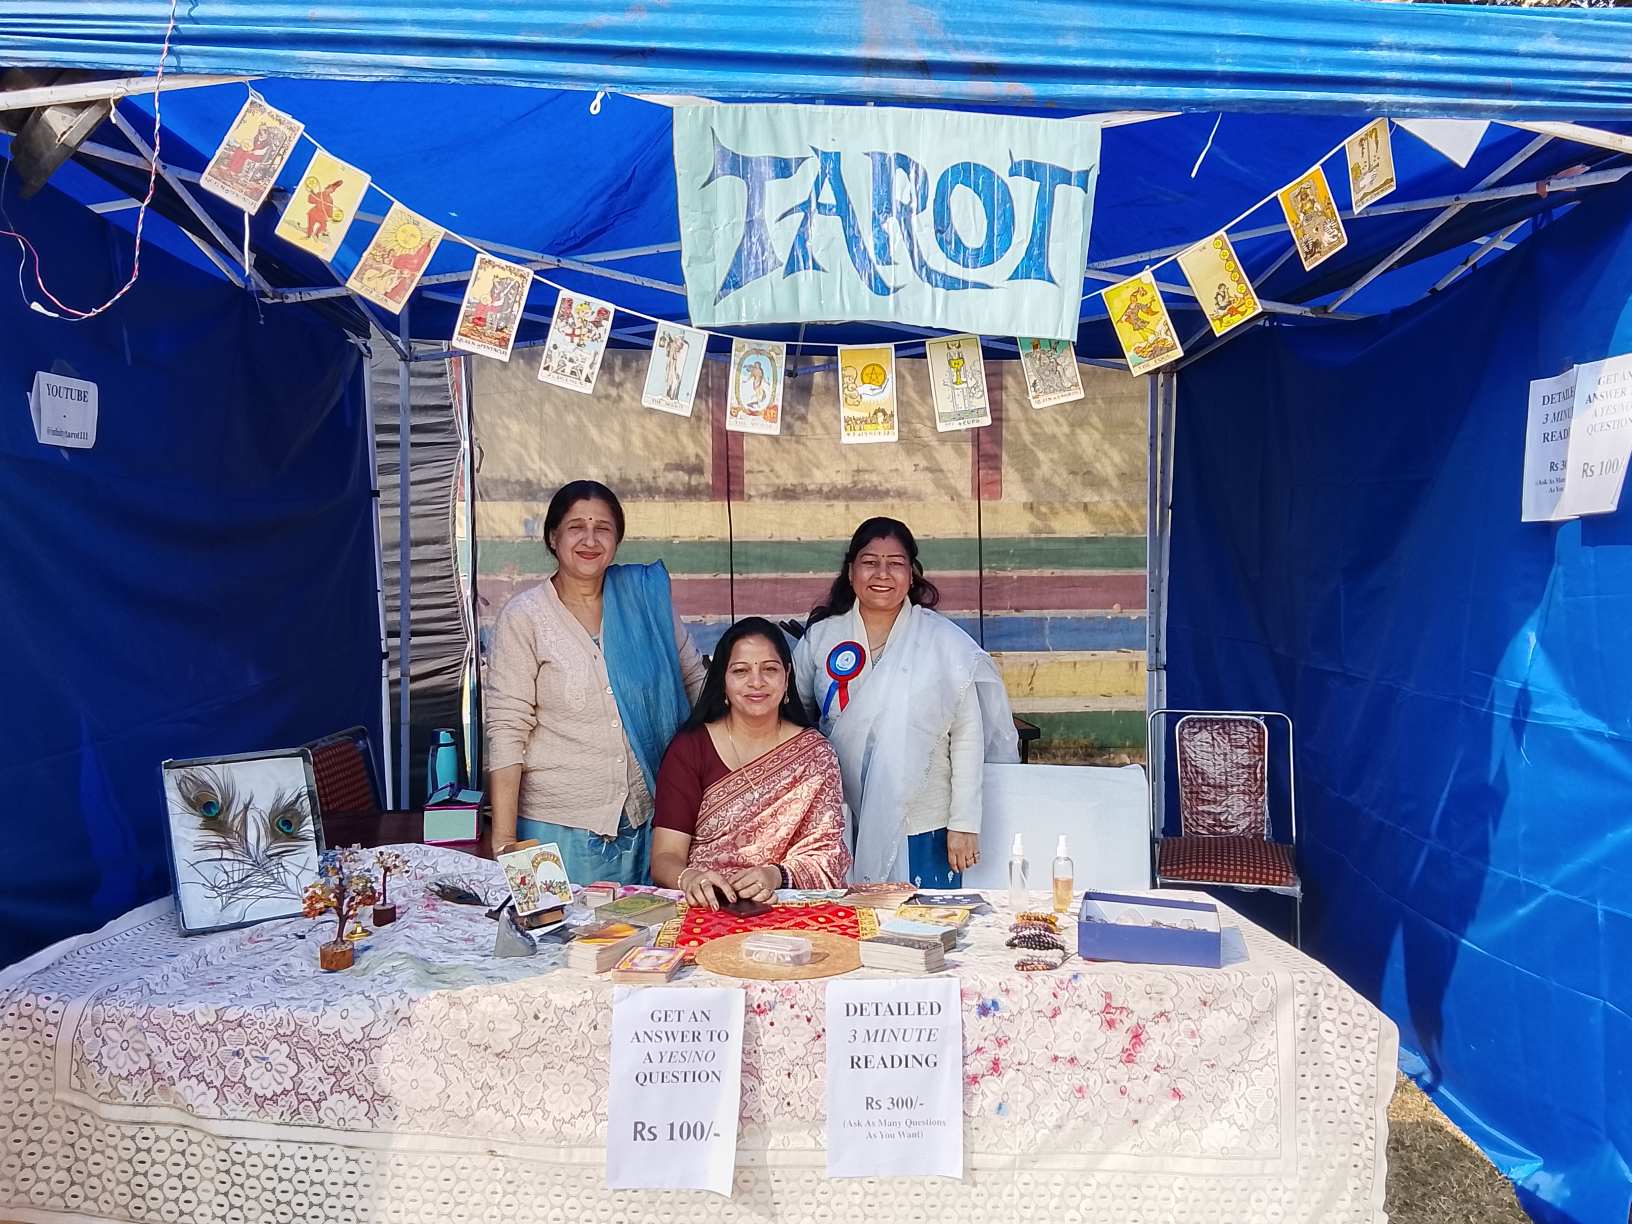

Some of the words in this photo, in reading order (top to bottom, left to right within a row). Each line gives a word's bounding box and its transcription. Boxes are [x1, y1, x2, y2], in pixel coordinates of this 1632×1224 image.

[698, 126, 1096, 306] TAROT
[46, 383, 89, 403] YOUTUBE
[1542, 384, 1576, 406] DETAILE
[1542, 413, 1549, 424] 3
[1550, 406, 1574, 423] MINU
[1542, 428, 1570, 443] READ
[1549, 461, 1559, 472] Rs
[1582, 462, 1595, 479] Rs
[650, 1009, 685, 1023] GET
[688, 1009, 712, 1023] AN
[845, 1001, 942, 1017] DETAILED
[631, 1030, 702, 1044] ANSWER
[707, 1029, 729, 1043] TO
[848, 1029, 858, 1043] 3
[862, 1027, 939, 1043] MINUTE
[642, 1051, 654, 1064] A
[658, 1050, 716, 1064] YES/NO
[850, 1054, 937, 1069] READING
[635, 1070, 722, 1086] QUESTION
[865, 1096, 882, 1111] Rs
[887, 1095, 924, 1111] 300/-
[633, 1121, 657, 1141] Rs
[666, 1120, 721, 1142] 100/-
[843, 1119, 863, 1128] (Ask
[865, 1119, 876, 1128] As
[878, 1118, 902, 1129] Many
[904, 1118, 947, 1129] Questions
[866, 1131, 877, 1140] As
[879, 1131, 895, 1140] You
[898, 1130, 924, 1140] Want)
